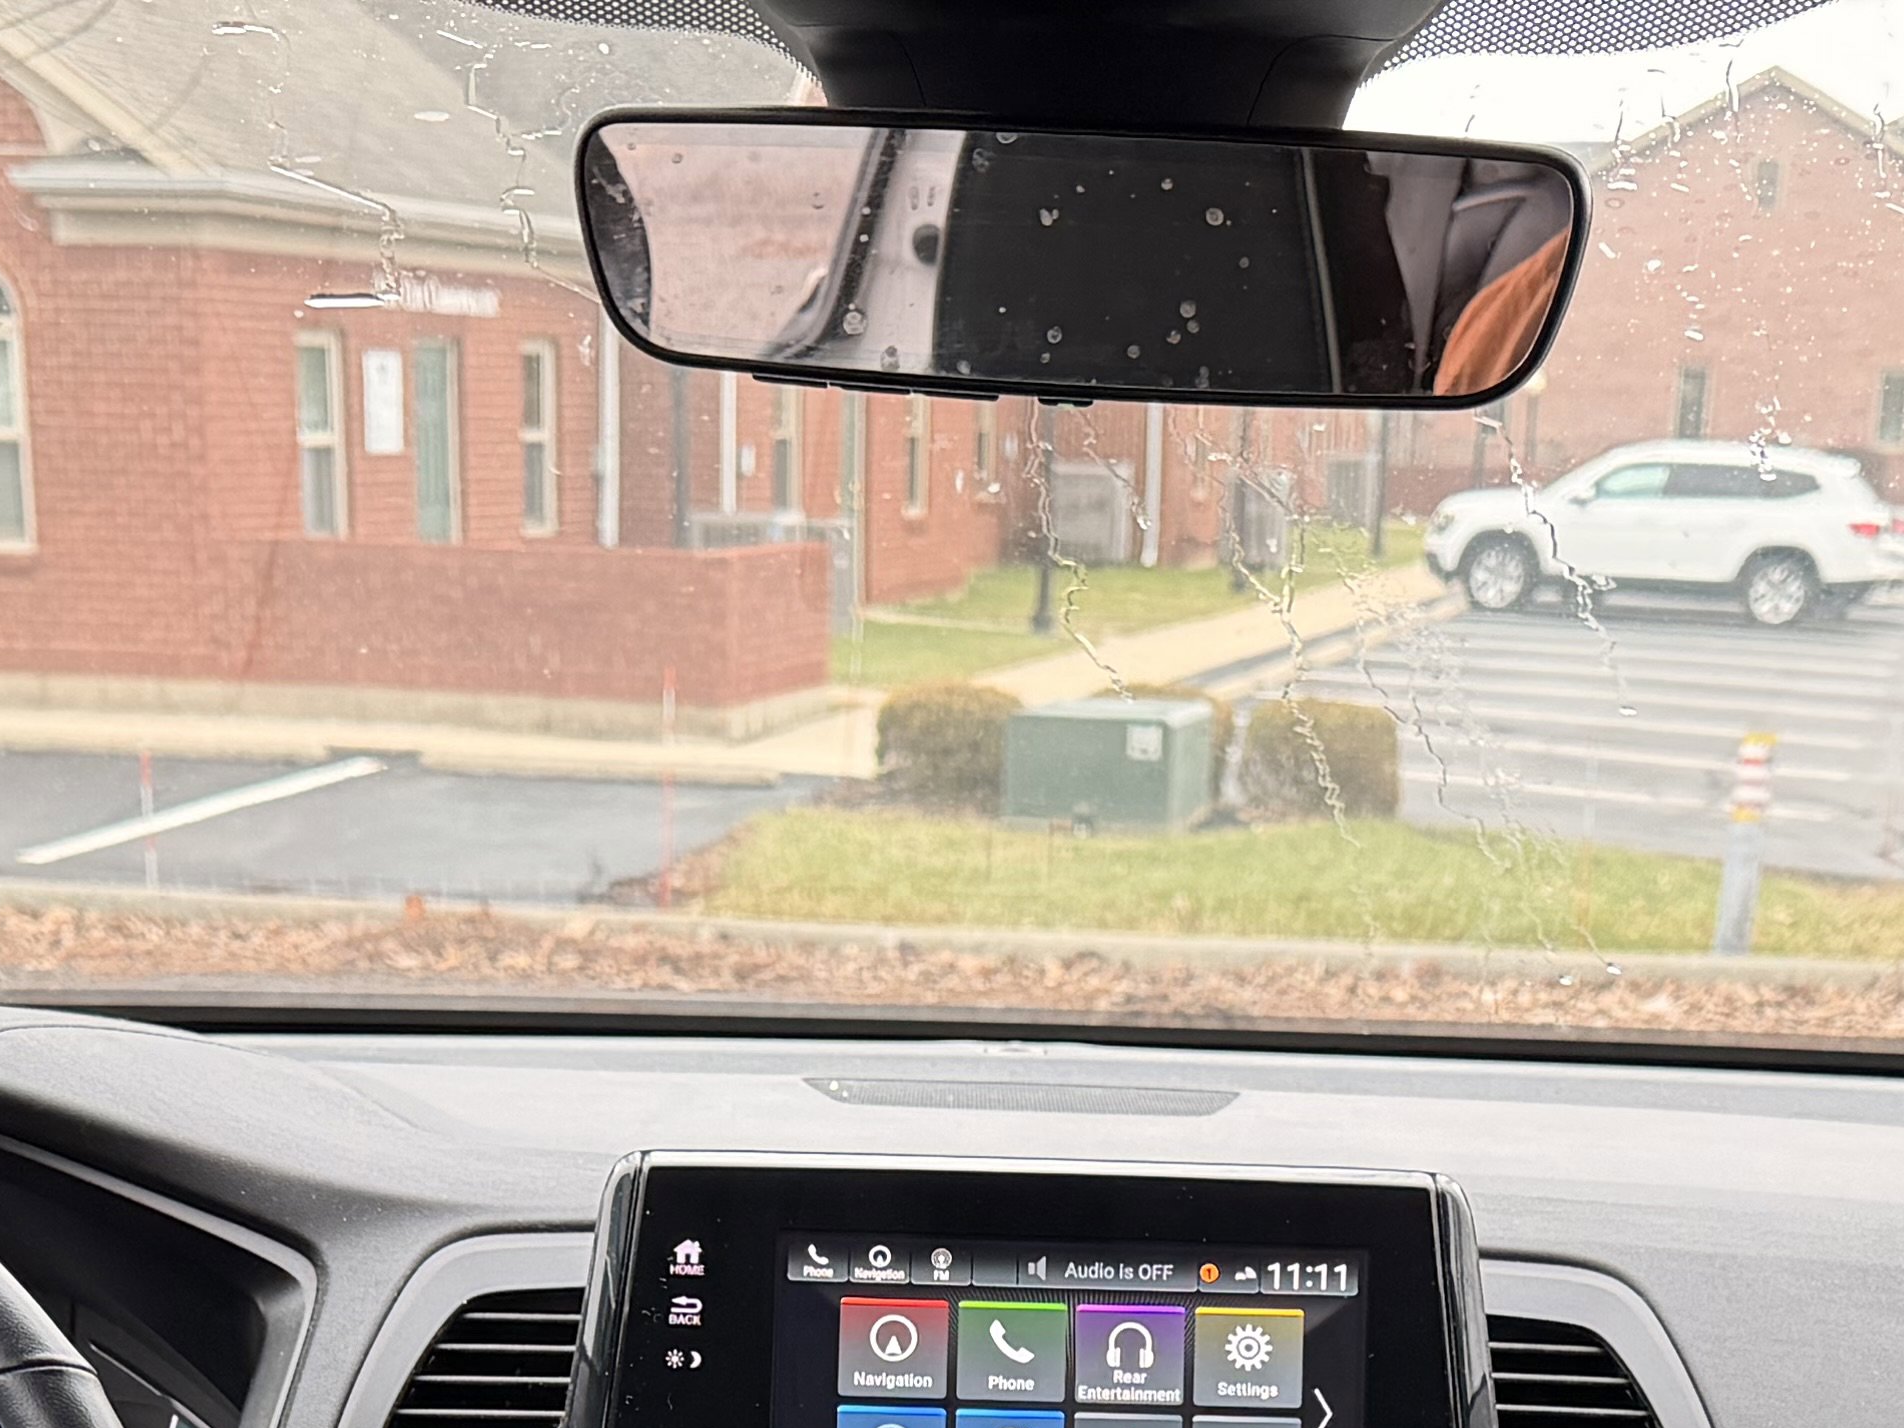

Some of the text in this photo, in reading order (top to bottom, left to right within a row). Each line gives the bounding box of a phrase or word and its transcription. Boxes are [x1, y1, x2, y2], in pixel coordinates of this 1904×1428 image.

[669, 1264, 705, 1277] HOME
[802, 1265, 834, 1278] Phone
[854, 1267, 906, 1282] Navigation
[933, 1269, 950, 1281] FM
[1063, 1262, 1115, 1280] Audio
[1137, 1263, 1174, 1281] OFF
[1266, 1262, 1349, 1291] 11:11
[668, 1314, 702, 1327] BACK
[853, 1371, 933, 1391] Navigation
[988, 1375, 1036, 1392] Phone
[1112, 1369, 1147, 1385] Rear
[1077, 1385, 1182, 1402] Entertainment
[1216, 1382, 1279, 1400] Settings
